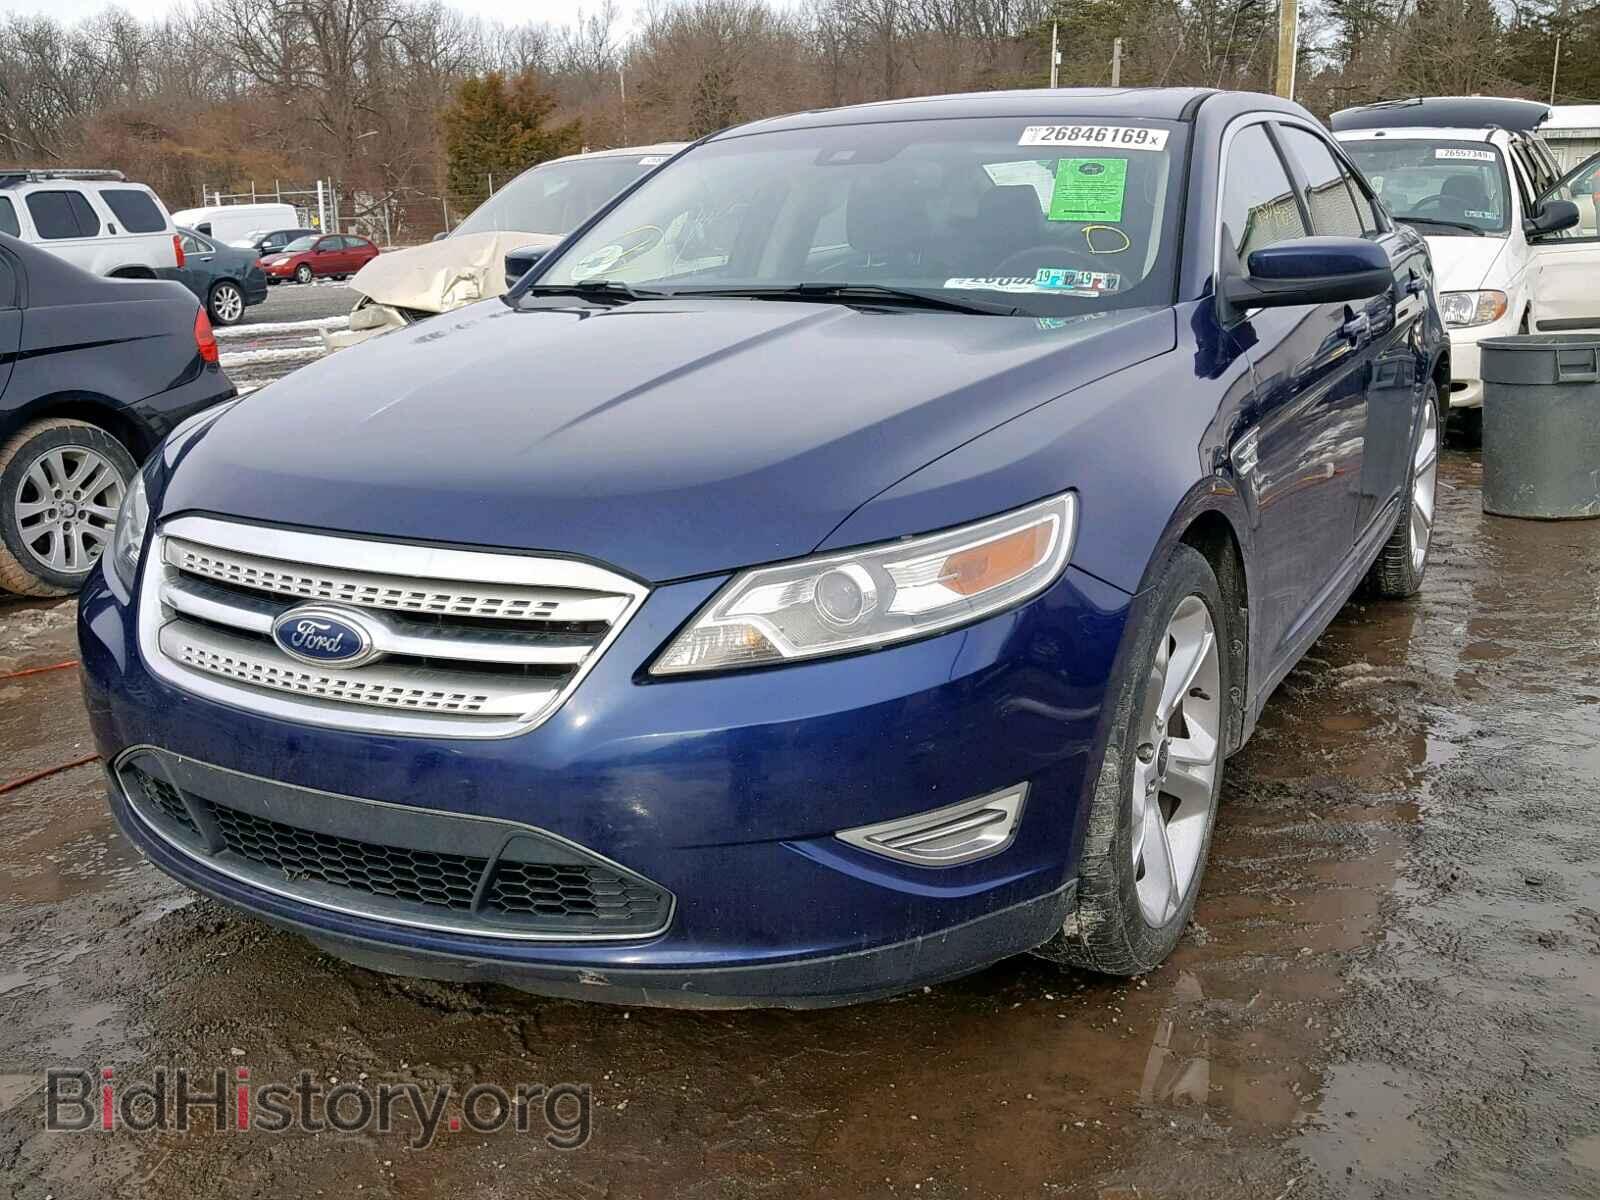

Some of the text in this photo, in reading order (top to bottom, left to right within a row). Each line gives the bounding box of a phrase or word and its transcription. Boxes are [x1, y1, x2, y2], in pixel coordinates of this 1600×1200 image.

[1038, 270, 1051, 282] 19
[1080, 272, 1092, 284] 19
[291, 620, 345, 653] Ford
